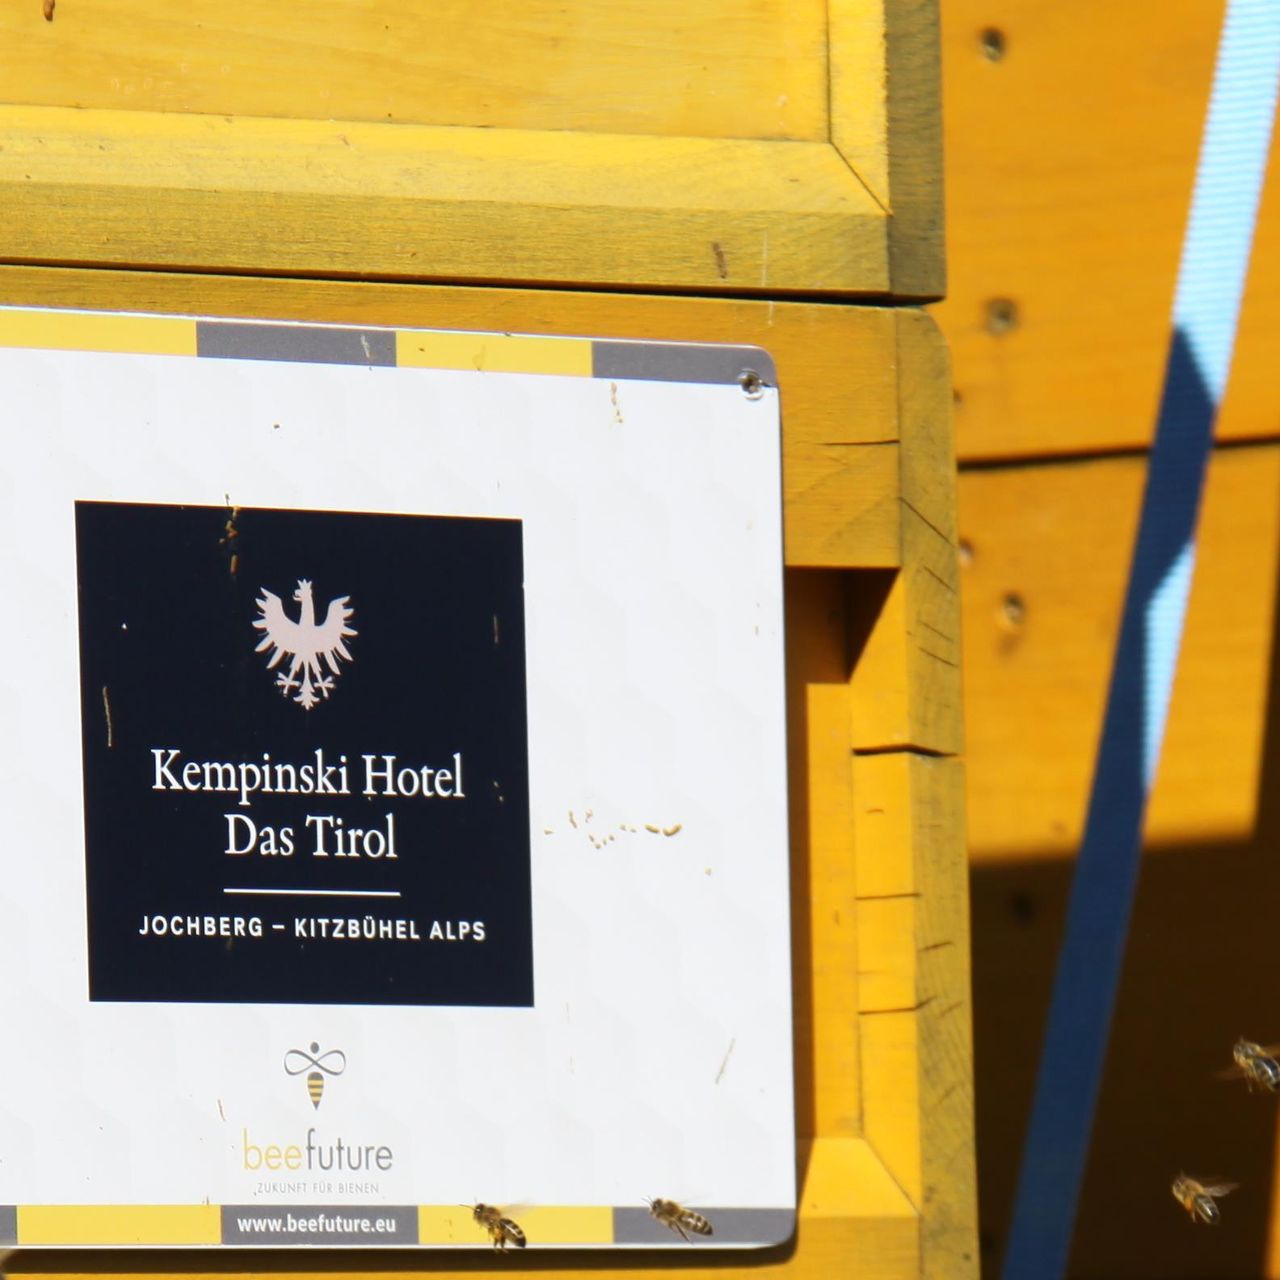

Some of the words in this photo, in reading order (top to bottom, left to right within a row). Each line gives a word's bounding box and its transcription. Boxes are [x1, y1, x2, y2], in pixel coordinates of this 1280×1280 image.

[150, 748, 351, 806] Kempinski
[361, 752, 466, 799] Hotel
[223, 813, 295, 857] Das
[305, 812, 399, 859] Tirol
[138, 915, 264, 938] JOCHBERG
[294, 915, 421, 940] KITZBÜHEL
[429, 920, 487, 941] ALPS
[243, 1127, 394, 1171] beefuture
[257, 1182, 308, 1194] ZUKUNFT
[338, 1182, 380, 1194] BIENEN
[236, 1213, 397, 1234] www.beefuture.eu
